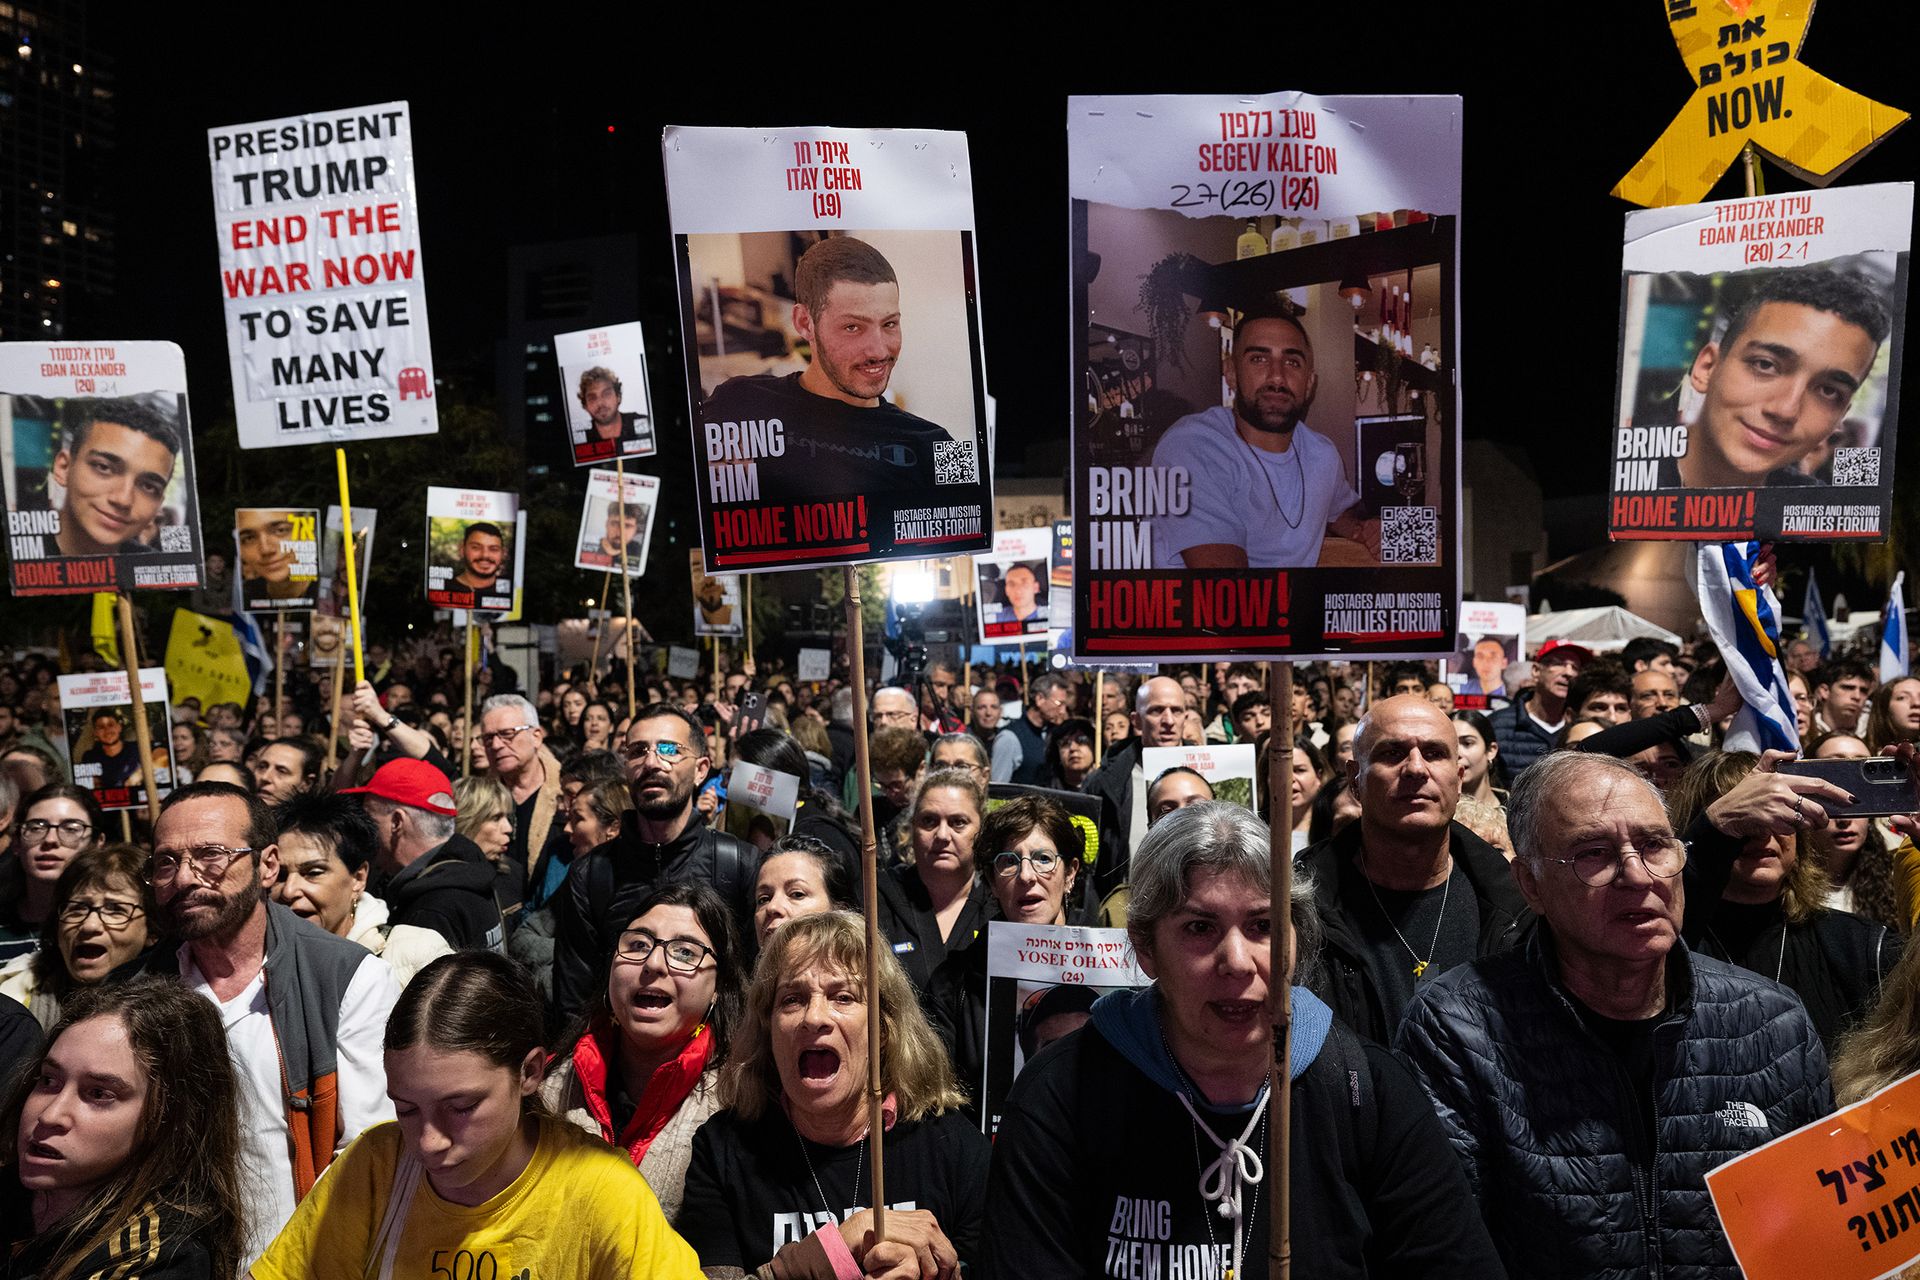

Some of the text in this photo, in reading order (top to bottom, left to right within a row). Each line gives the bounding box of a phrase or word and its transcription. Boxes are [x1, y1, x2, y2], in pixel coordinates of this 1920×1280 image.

[1718, 15, 1766, 49] את
[1700, 42, 1790, 89] כולם
[1708, 76, 1792, 138] NOW.
[213, 111, 403, 161] PRESIDENT
[1220, 109, 1316, 141] שגב כלפון
[794, 141, 850, 167] איתי חן
[1199, 143, 1338, 174] SEGEV KALFON
[233, 156, 388, 206] TRUMP
[786, 168, 862, 191] ITAY CHEN
[812, 192, 842, 218] (19)
[1714, 196, 1812, 223] עידן אלכסנדר
[231, 203, 400, 250] END THE
[1699, 216, 1824, 246] EDAN ALEXANDER
[224, 249, 415, 299] WAR NOW
[240, 297, 410, 342] TO SAVE
[40, 364, 126, 376] EDAN ALEXANDER
[48, 348, 115, 362] עידן אלכסנדר
[272, 348, 386, 386] MANY
[75, 379, 95, 394] (20)
[278, 394, 390, 430] LIVES
[704, 418, 785, 462] BRING
[1616, 426, 1688, 459] BRING
[709, 462, 760, 504] HIM
[1088, 466, 1192, 516] BRING
[1614, 460, 1659, 492] HIM
[8, 510, 60, 535] BRING
[713, 496, 868, 549] HOME NOW!
[894, 504, 981, 522] HOSTAGES AND MISSING
[1612, 491, 1755, 528] HOME NOW!
[1782, 516, 1880, 532] FAMILIES FORUM
[1783, 505, 1880, 516] HOSTAGES AND MISSING
[894, 518, 981, 540] FAMILIES FORUM
[10, 536, 45, 560] HIM
[1090, 521, 1152, 570] HIM
[14, 556, 117, 586] HOME NOW!
[134, 572, 198, 585] FAMILIES FORUM
[1090, 572, 1290, 629] HOME NOW!
[1324, 592, 1441, 610] HOSTAGES AND MISSING
[1324, 610, 1388, 633] FAMILIES
[1390, 609, 1441, 632] FORUM
[1017, 950, 1130, 969] YOSEF OHANA
[1026, 938, 1123, 954] יוסף חיים אוחנה
[1062, 971, 1085, 984] (24)
[1714, 1110, 1746, 1118] NORTH
[1726, 1100, 1744, 1110] THE
[1724, 1118, 1748, 1127] FACE
[1816, 1128, 1920, 1206] מי יציל
[1110, 1195, 1171, 1240] BRING
[432, 1250, 498, 1280] 500
[1104, 1236, 1232, 1280] THEM HOME
